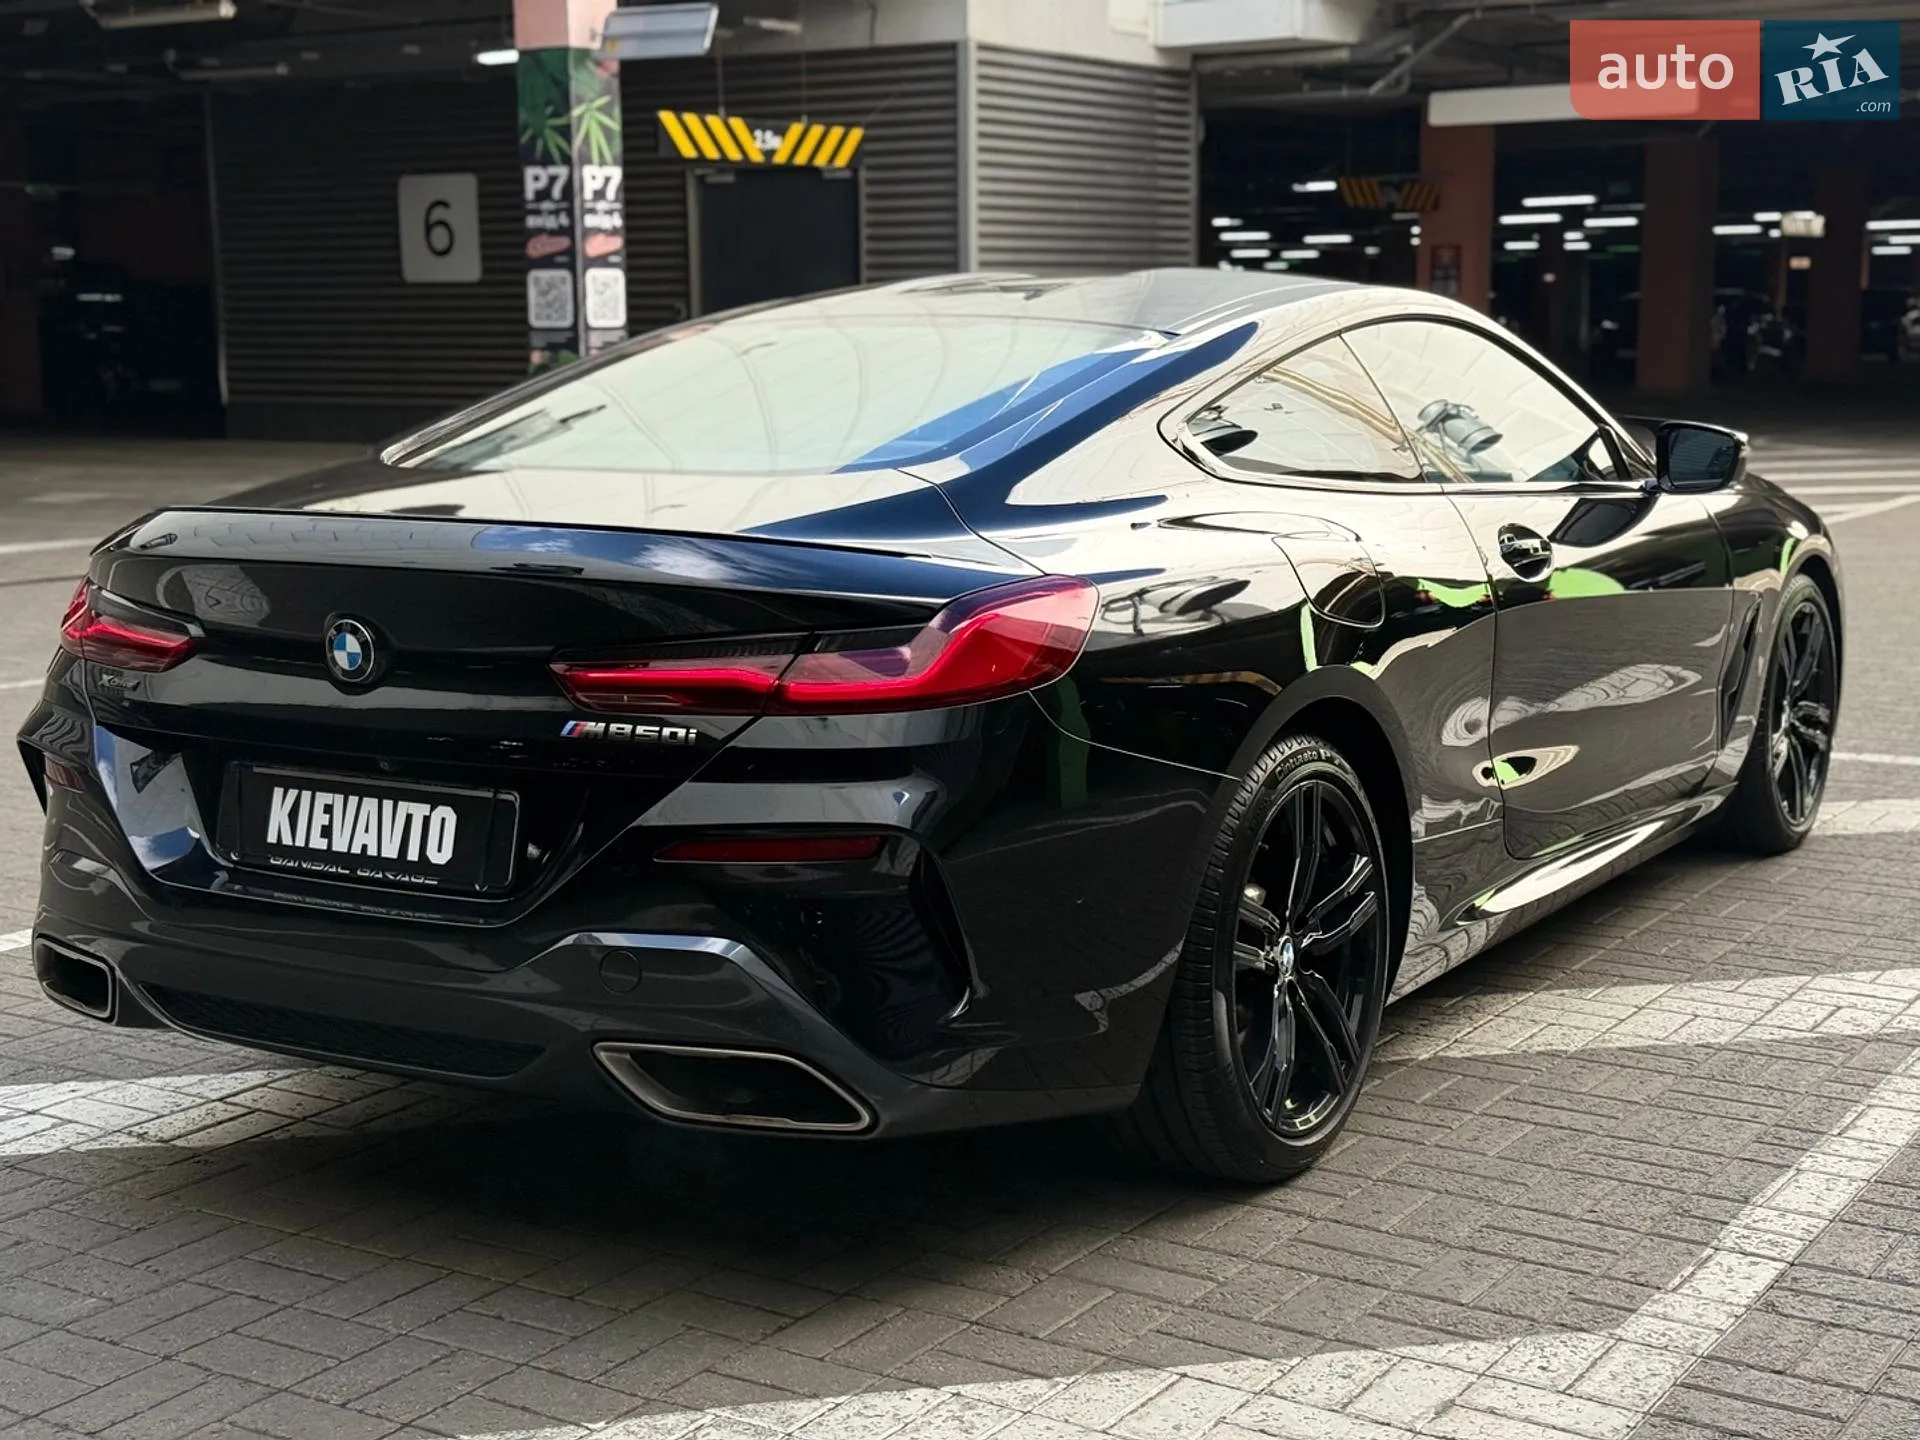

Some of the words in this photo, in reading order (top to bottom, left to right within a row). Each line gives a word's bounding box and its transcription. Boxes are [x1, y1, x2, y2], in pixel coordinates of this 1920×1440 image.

[523, 164, 570, 200] P7
[582, 164, 623, 200] P7
[424, 199, 455, 257] 6
[579, 720, 698, 745] M850i
[266, 786, 458, 865] KIEVAVTO
